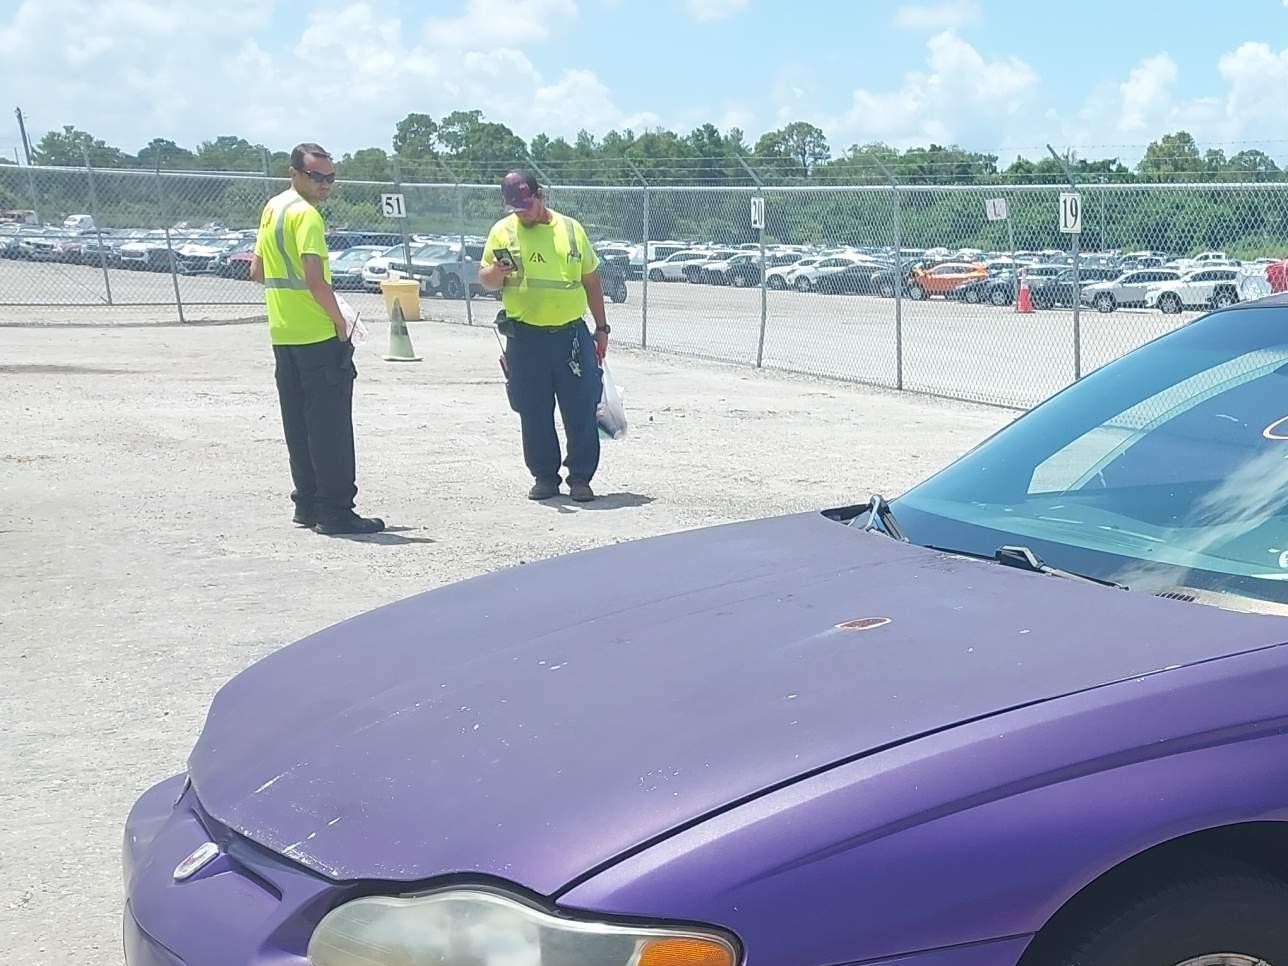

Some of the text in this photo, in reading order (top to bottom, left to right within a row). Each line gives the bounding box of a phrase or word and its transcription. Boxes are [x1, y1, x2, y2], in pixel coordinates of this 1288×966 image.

[386, 196, 402, 215] 51
[753, 200, 763, 226] 20
[1063, 197, 1079, 229] 19
